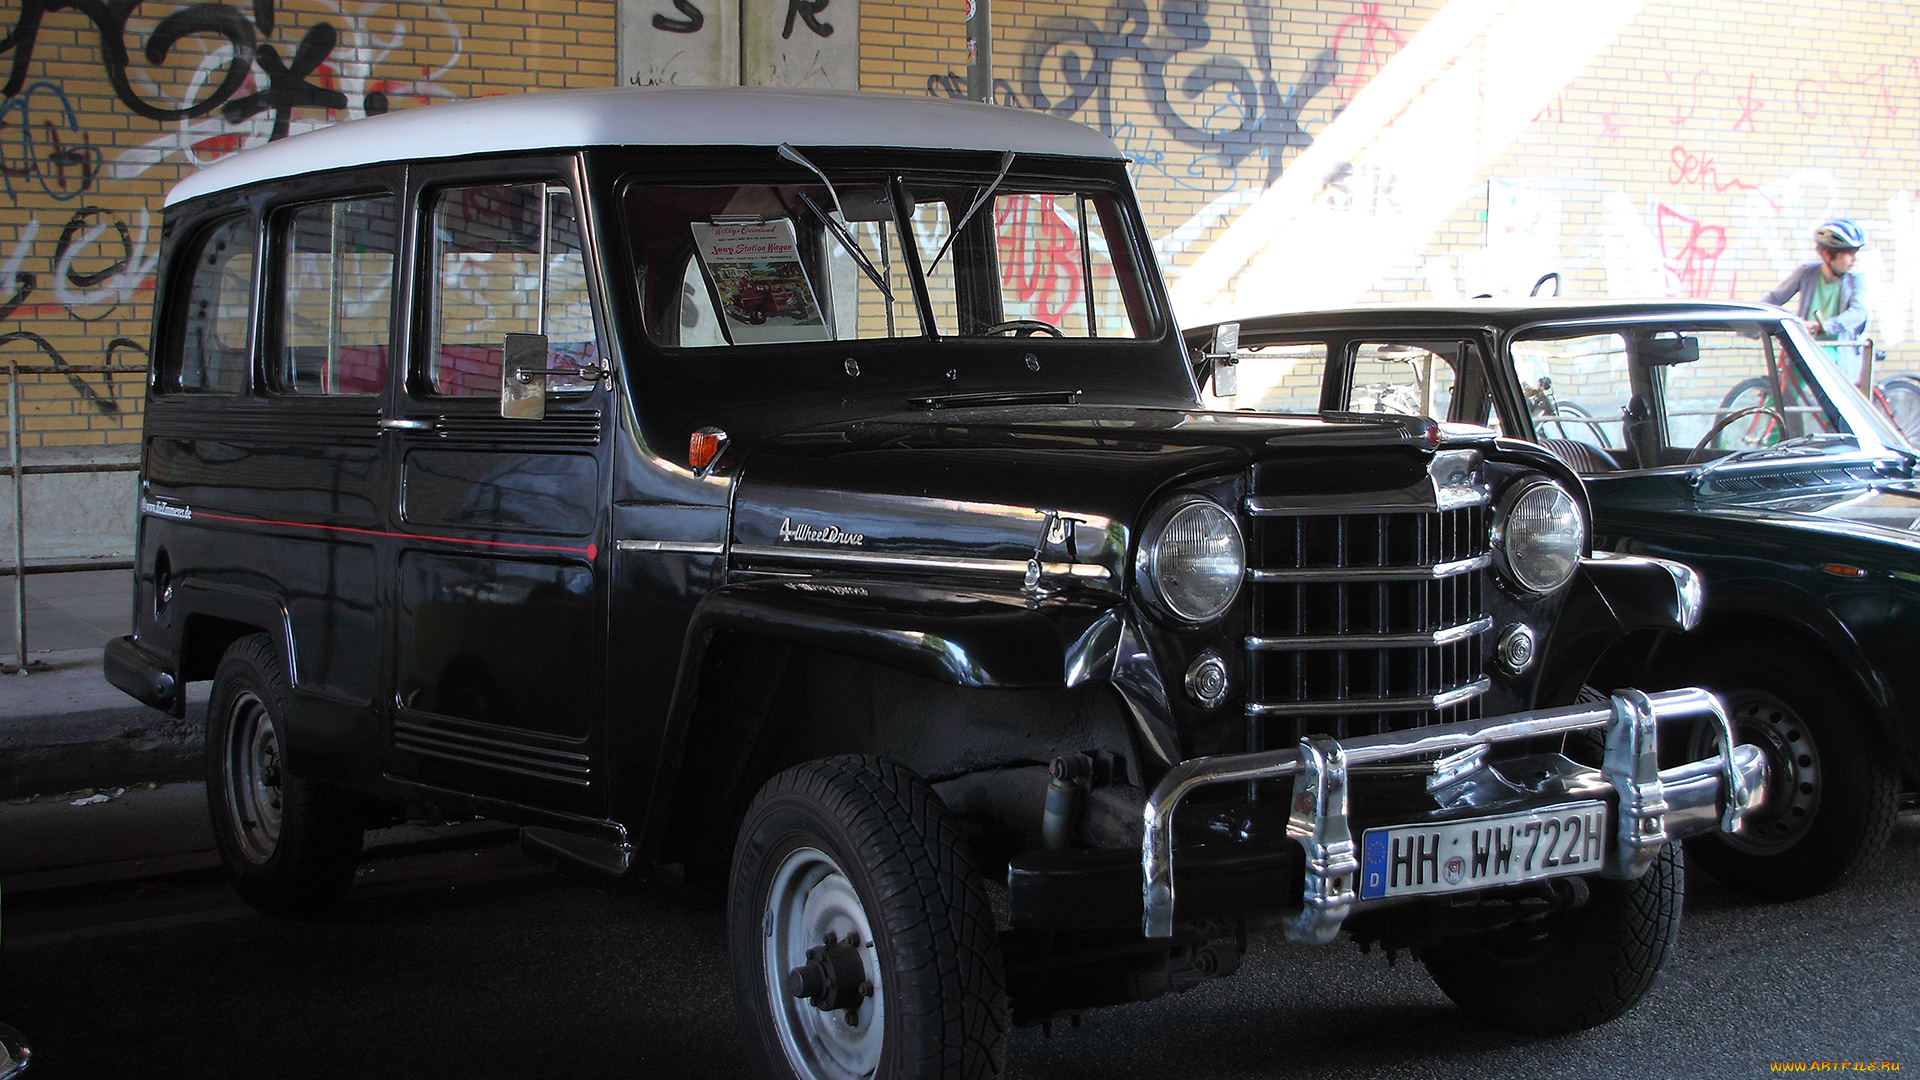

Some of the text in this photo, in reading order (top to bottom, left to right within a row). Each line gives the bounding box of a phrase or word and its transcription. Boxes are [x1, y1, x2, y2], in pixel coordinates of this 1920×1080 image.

[736, 244, 766, 254] Station
[767, 242, 792, 253] Wagon
[1390, 811, 1603, 888] HH WW 722H
[1370, 872, 1380, 888] D
